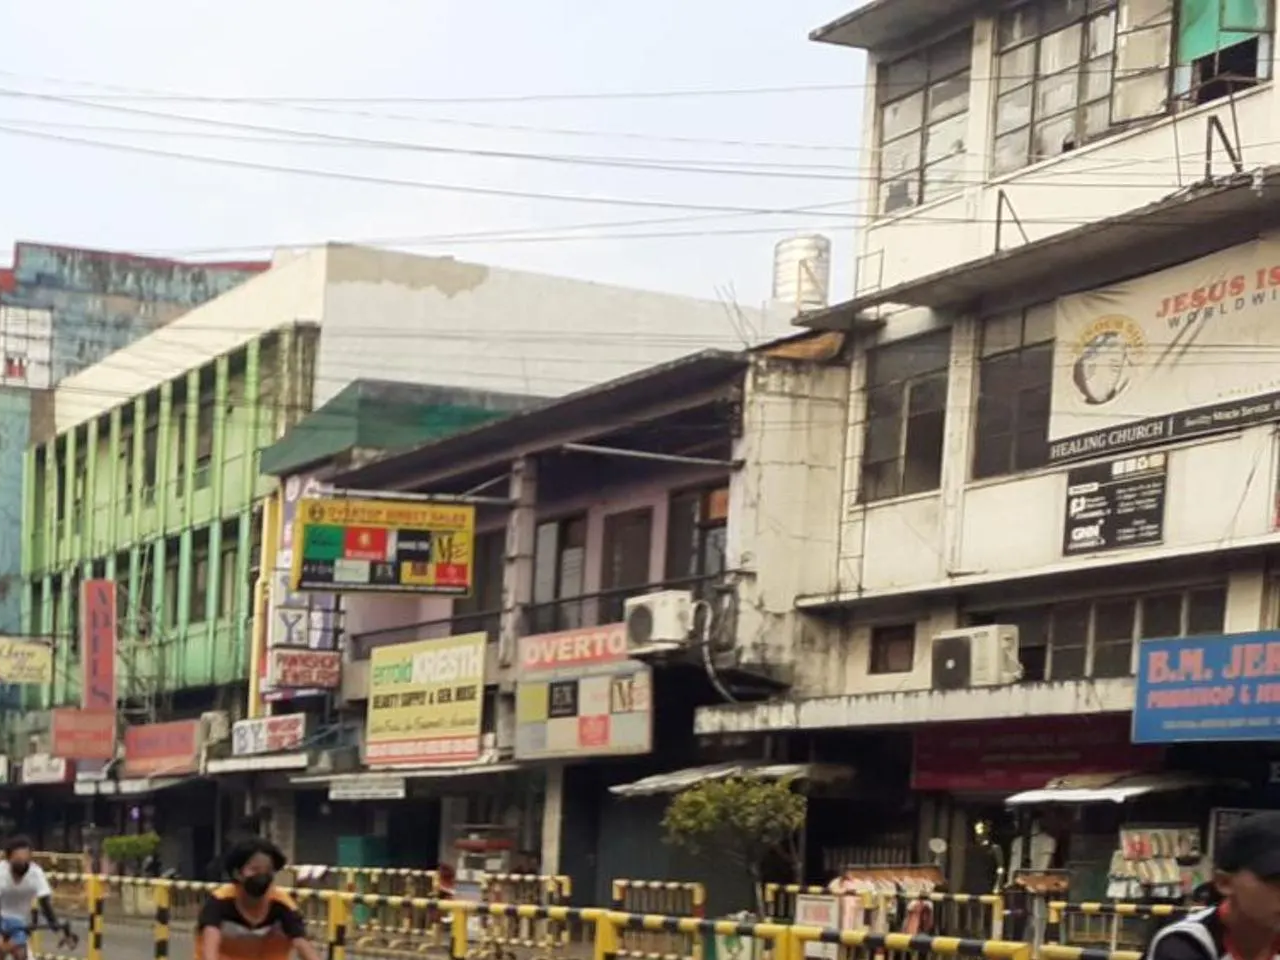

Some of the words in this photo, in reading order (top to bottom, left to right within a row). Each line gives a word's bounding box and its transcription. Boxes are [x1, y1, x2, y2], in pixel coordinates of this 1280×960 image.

[1155, 275, 1246, 318] JESUS
[1255, 264, 1280, 291] IS
[1050, 429, 1107, 460] HEALING
[1108, 420, 1164, 445] CHURCH
